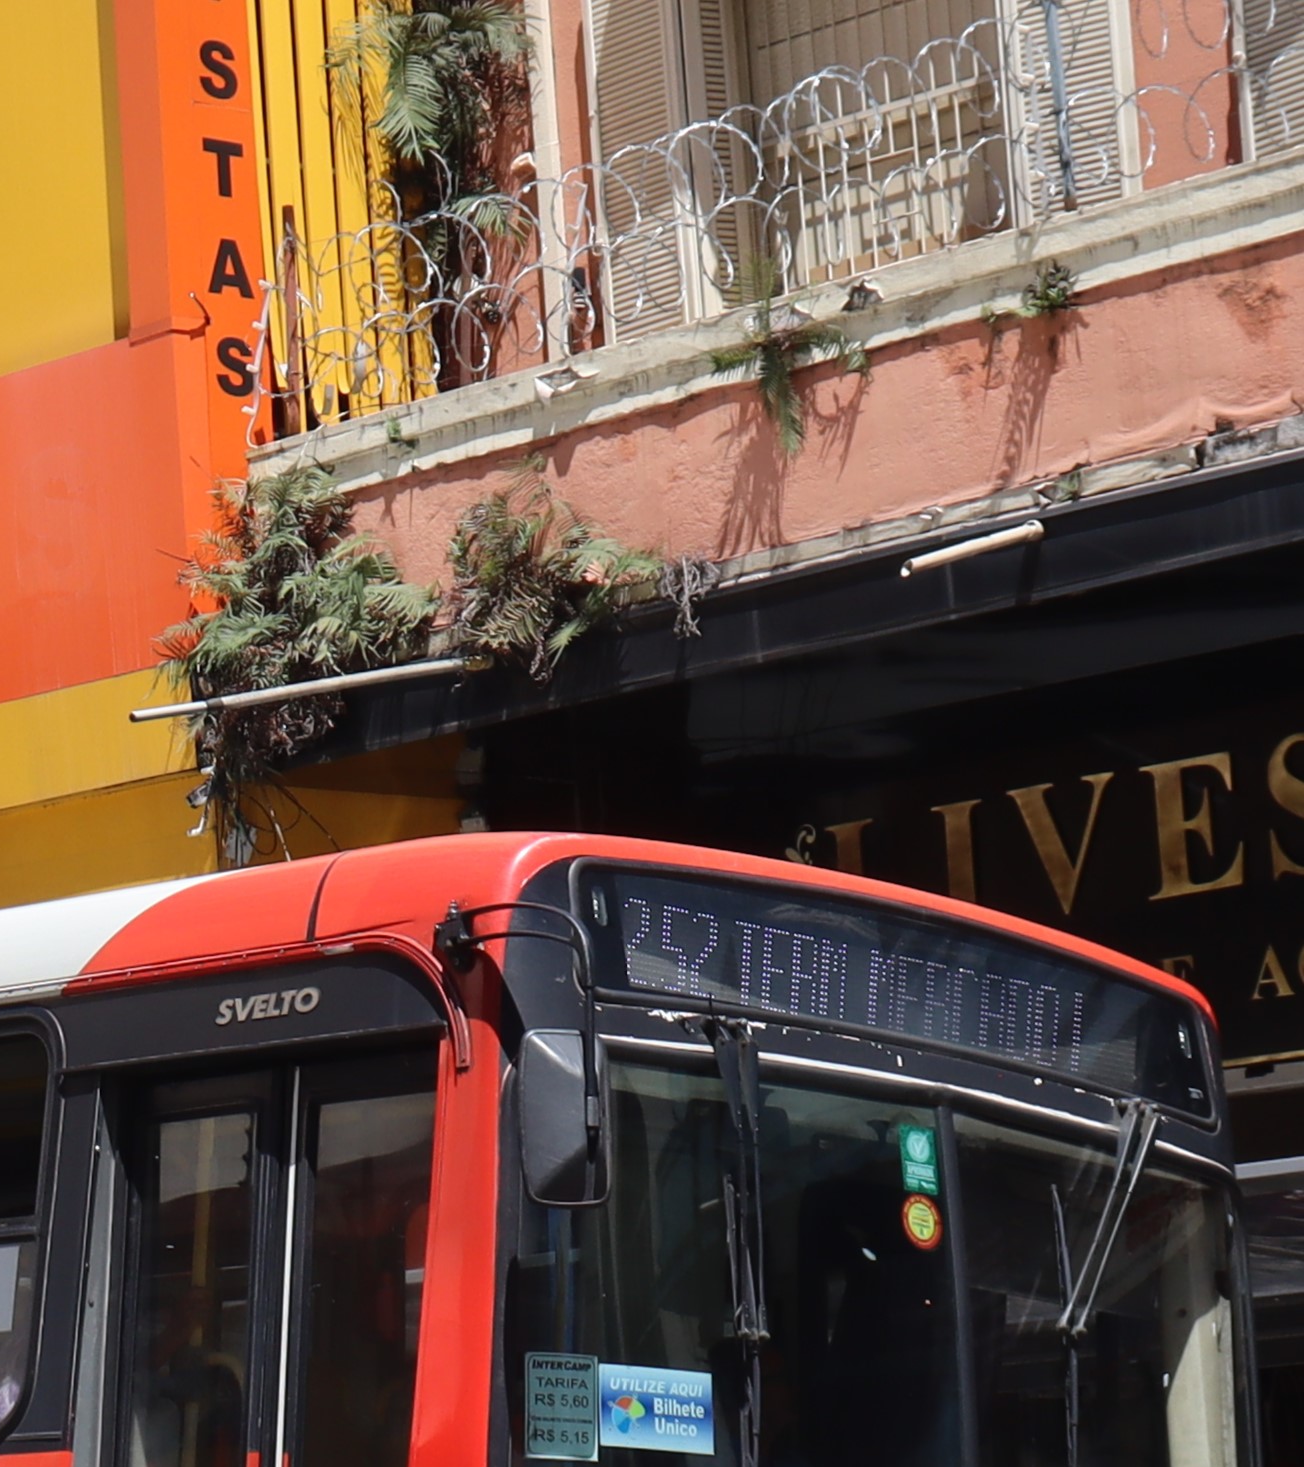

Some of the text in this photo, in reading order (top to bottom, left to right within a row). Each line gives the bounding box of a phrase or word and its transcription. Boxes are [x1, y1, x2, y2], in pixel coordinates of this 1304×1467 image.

[625, 897, 719, 999] 252
[1252, 944, 1304, 1000] A
[215, 987, 321, 1026] SVELTO
[535, 1376, 589, 1391] TARIFA
[610, 1376, 703, 1398] UTILIZE AQUI
[534, 1393, 590, 1409] R$ 5,60
[653, 1396, 705, 1419] Bilhete
[533, 1428, 590, 1445] R$ 5,15
